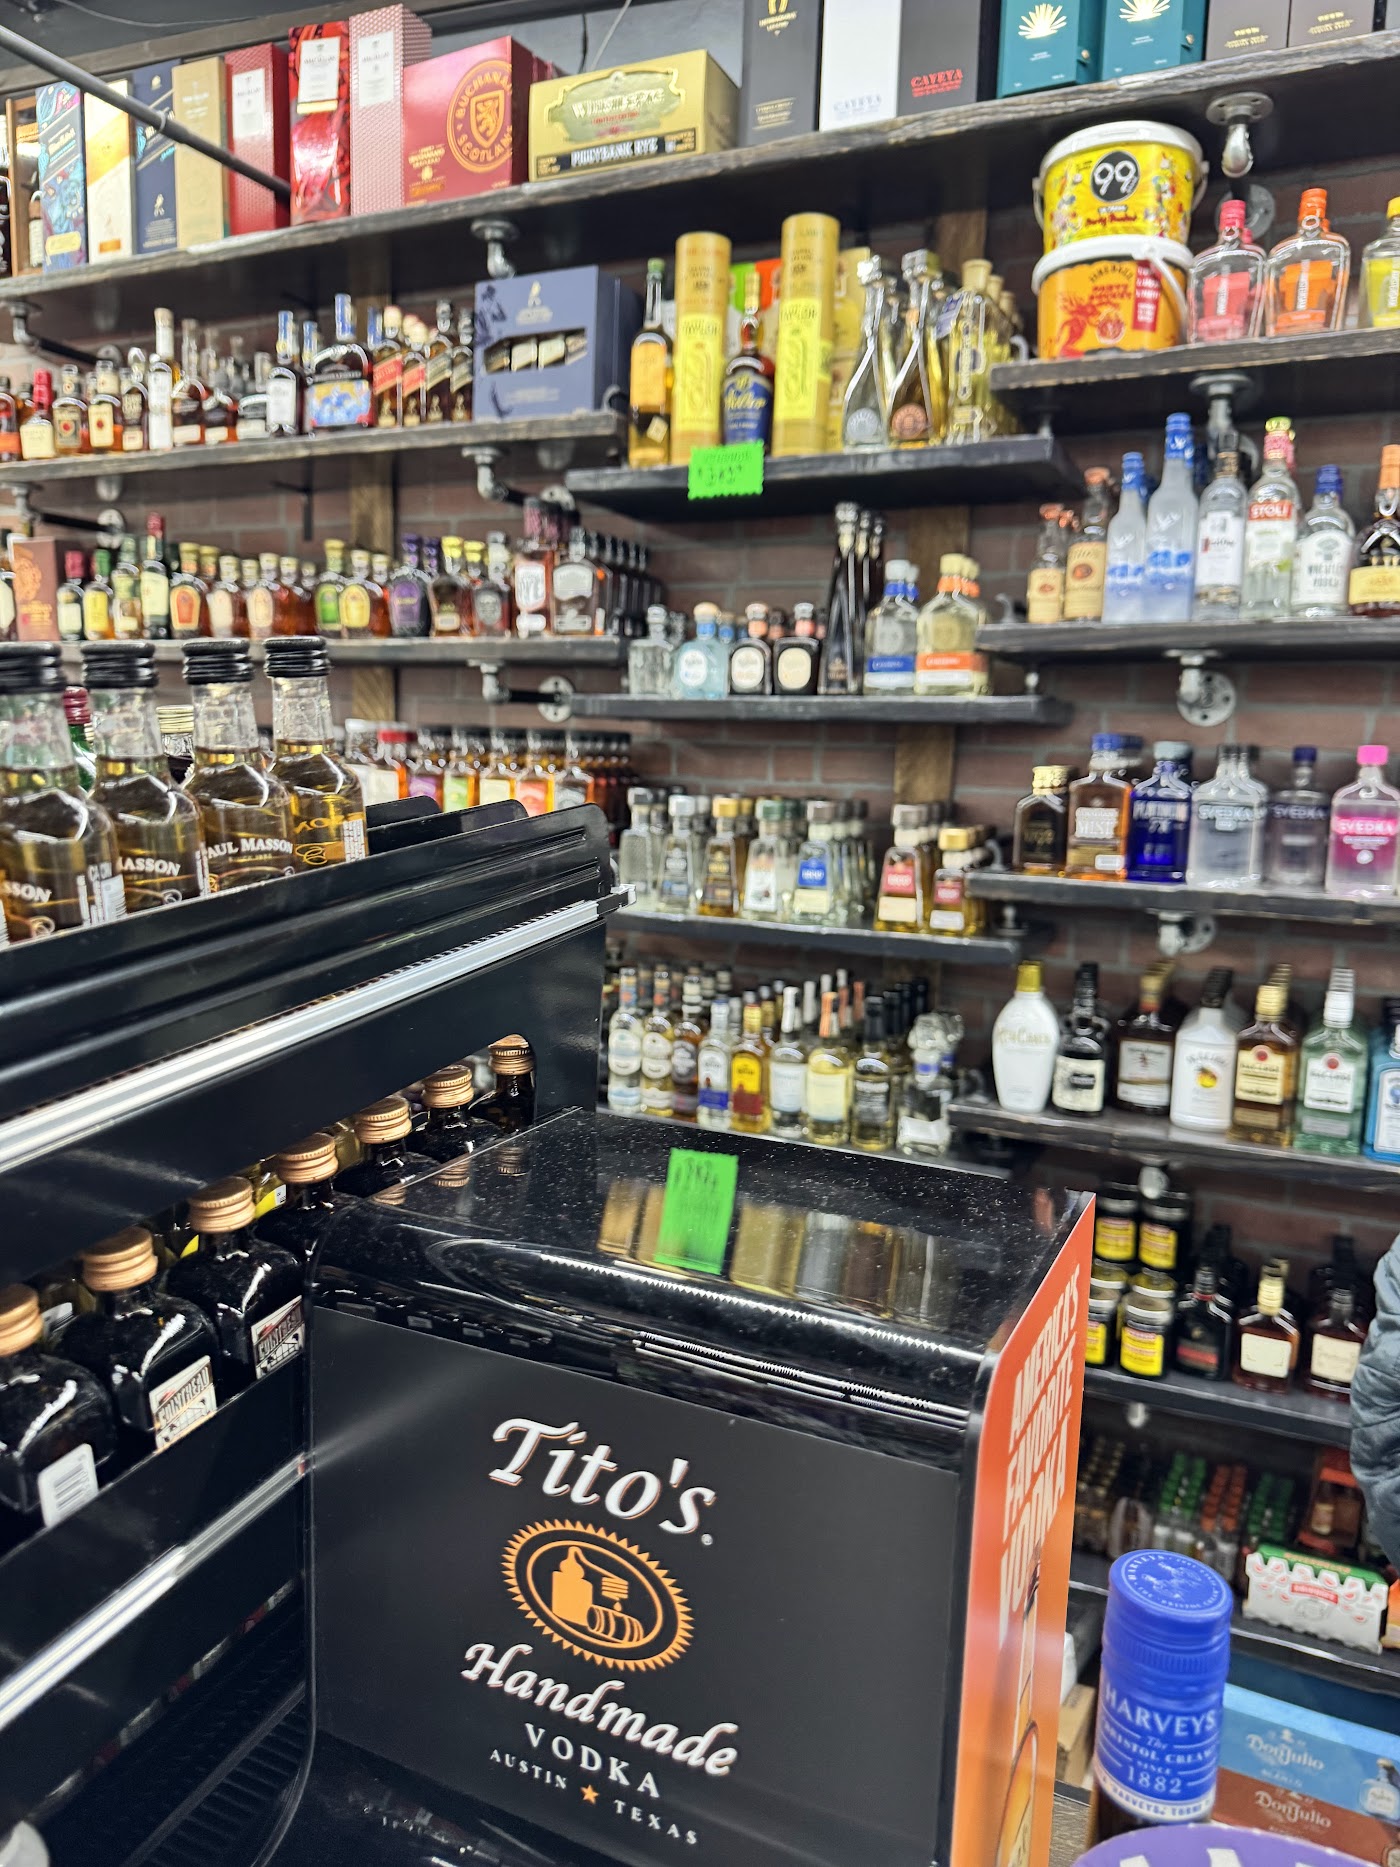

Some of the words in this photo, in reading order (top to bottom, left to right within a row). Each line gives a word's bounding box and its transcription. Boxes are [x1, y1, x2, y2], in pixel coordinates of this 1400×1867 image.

[1093, 160, 1137, 196] 99
[1250, 506, 1289, 518] STOLI
[1273, 805, 1327, 820] SVEDKA
[1340, 820, 1393, 833] SVEDKA
[240, 837, 294, 855] MASSON
[1009, 1262, 1081, 1455] AMERICA'S
[1002, 1331, 1077, 1544] FAVORITE
[488, 1417, 717, 1535] Tito's
[999, 1411, 1070, 1651] VODKA
[461, 1643, 739, 1777] Handmade
[1105, 1681, 1217, 1737] HARVEYS
[525, 1722, 660, 1799] VODKA
[1127, 1766, 1182, 1794] 1882
[490, 1748, 568, 1790] AUSTIN
[613, 1799, 698, 1845] TEXAS
